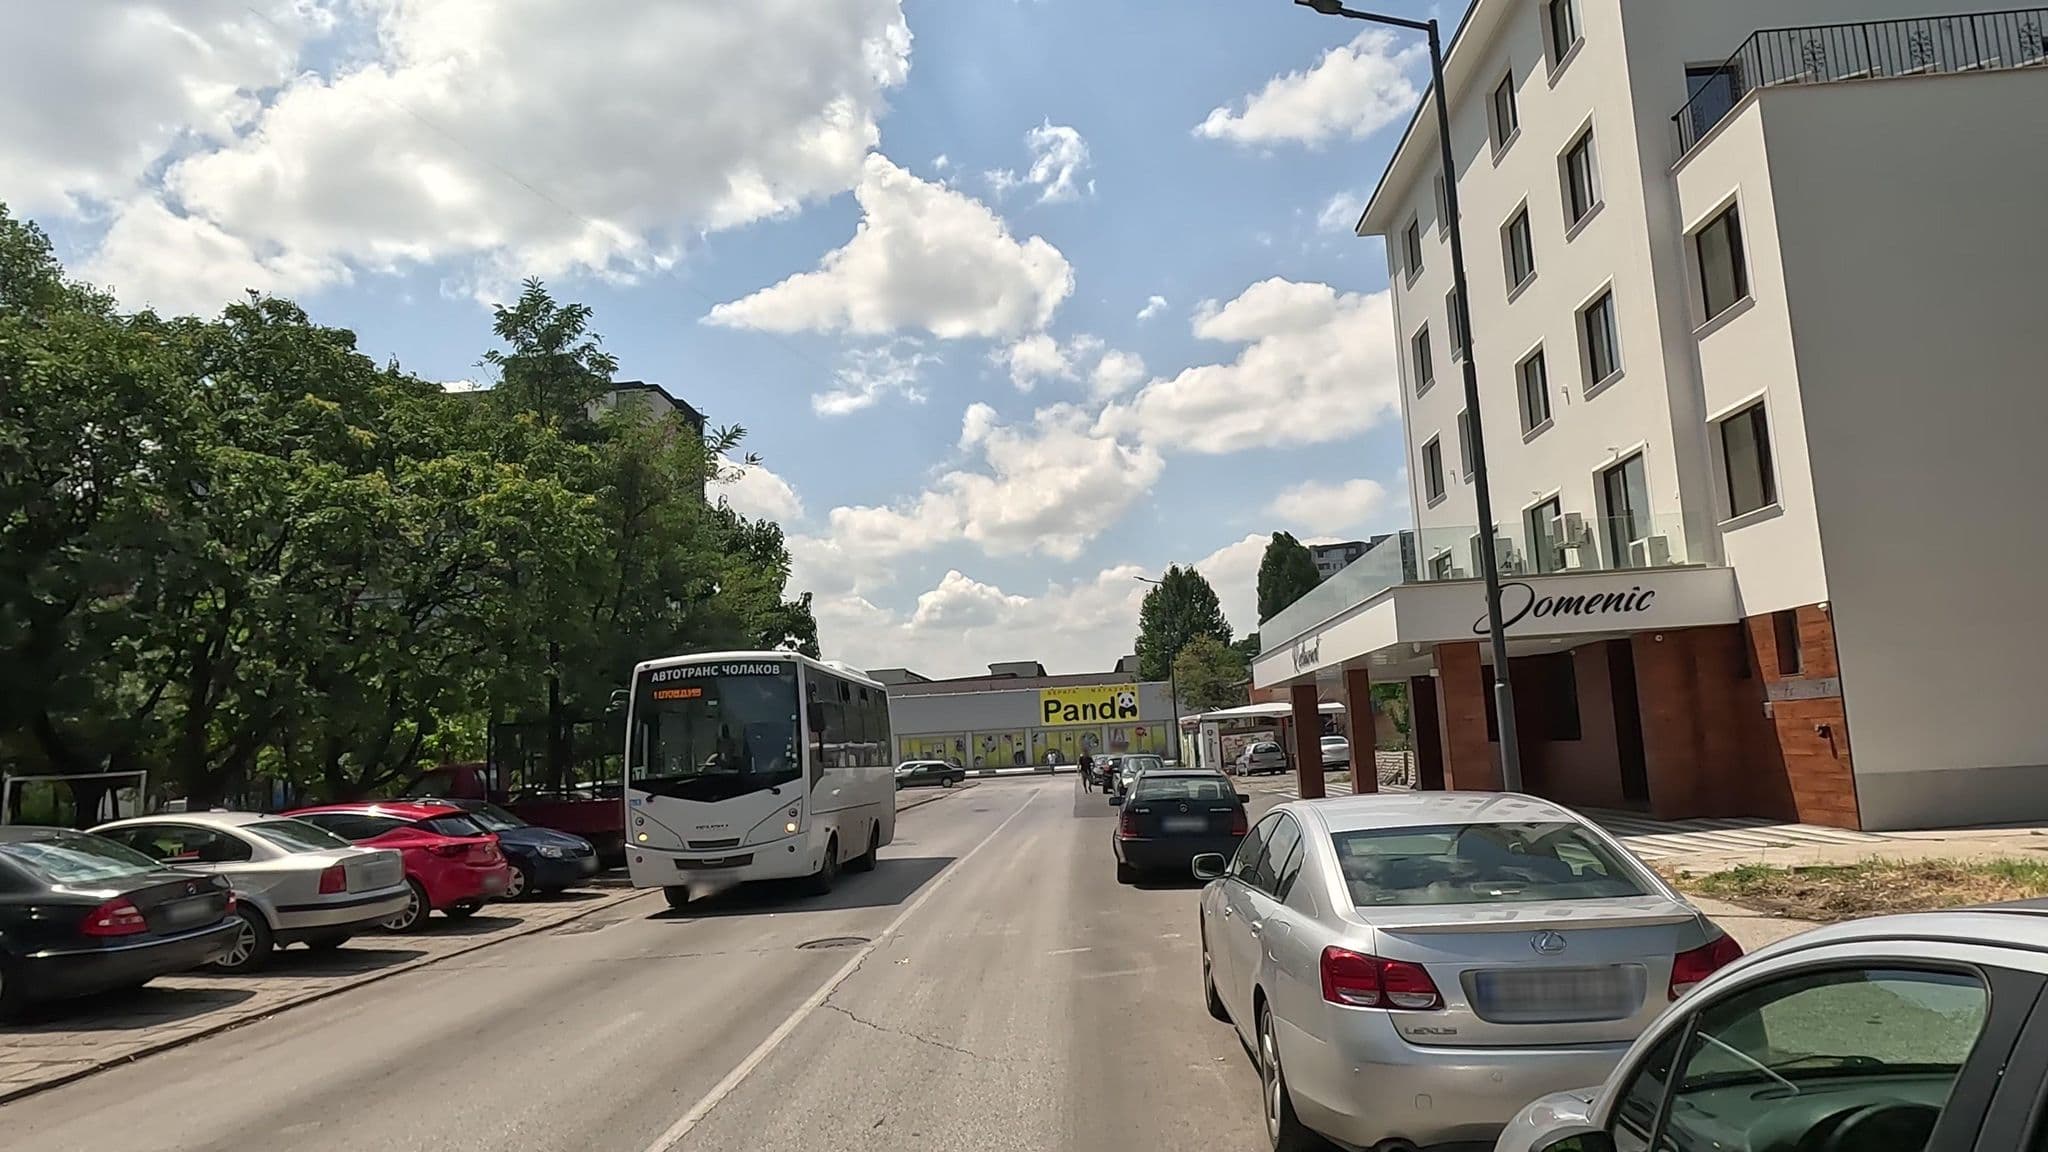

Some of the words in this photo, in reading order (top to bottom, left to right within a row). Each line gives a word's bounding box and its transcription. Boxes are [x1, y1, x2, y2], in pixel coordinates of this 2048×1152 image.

[1473, 582, 1655, 634] Domenic
[651, 665, 719, 683] АВТОТРАНС
[722, 664, 780, 675] ЧОЛАКОВ
